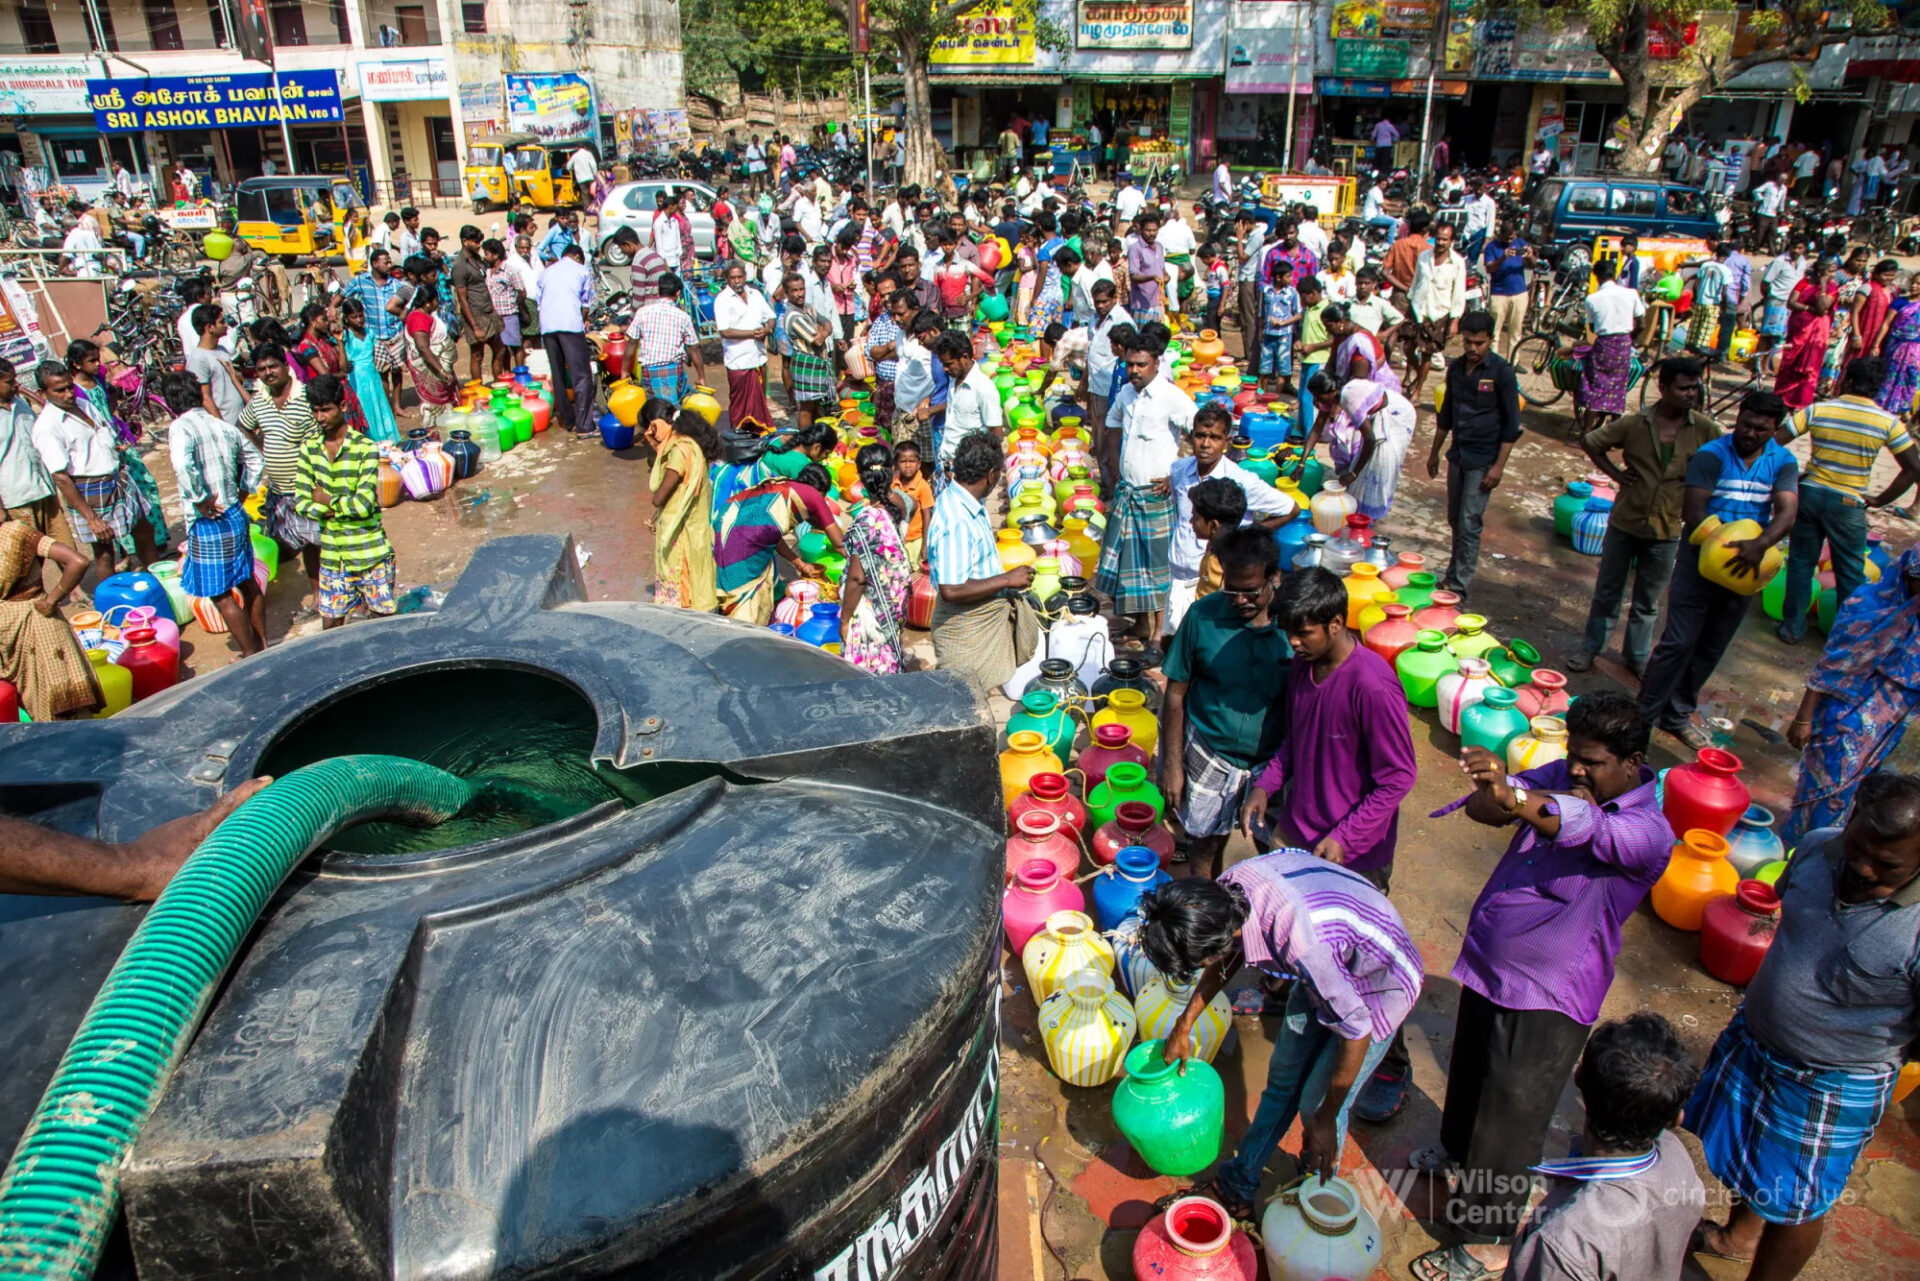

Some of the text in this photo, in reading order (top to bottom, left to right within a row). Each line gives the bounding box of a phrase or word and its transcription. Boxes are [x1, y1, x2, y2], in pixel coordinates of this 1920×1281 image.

[9, 79, 65, 90] SURGICALS
[132, 84, 221, 106] அசோக்
[106, 103, 329, 128] SRI ASHOK BHAVAAN VEG
